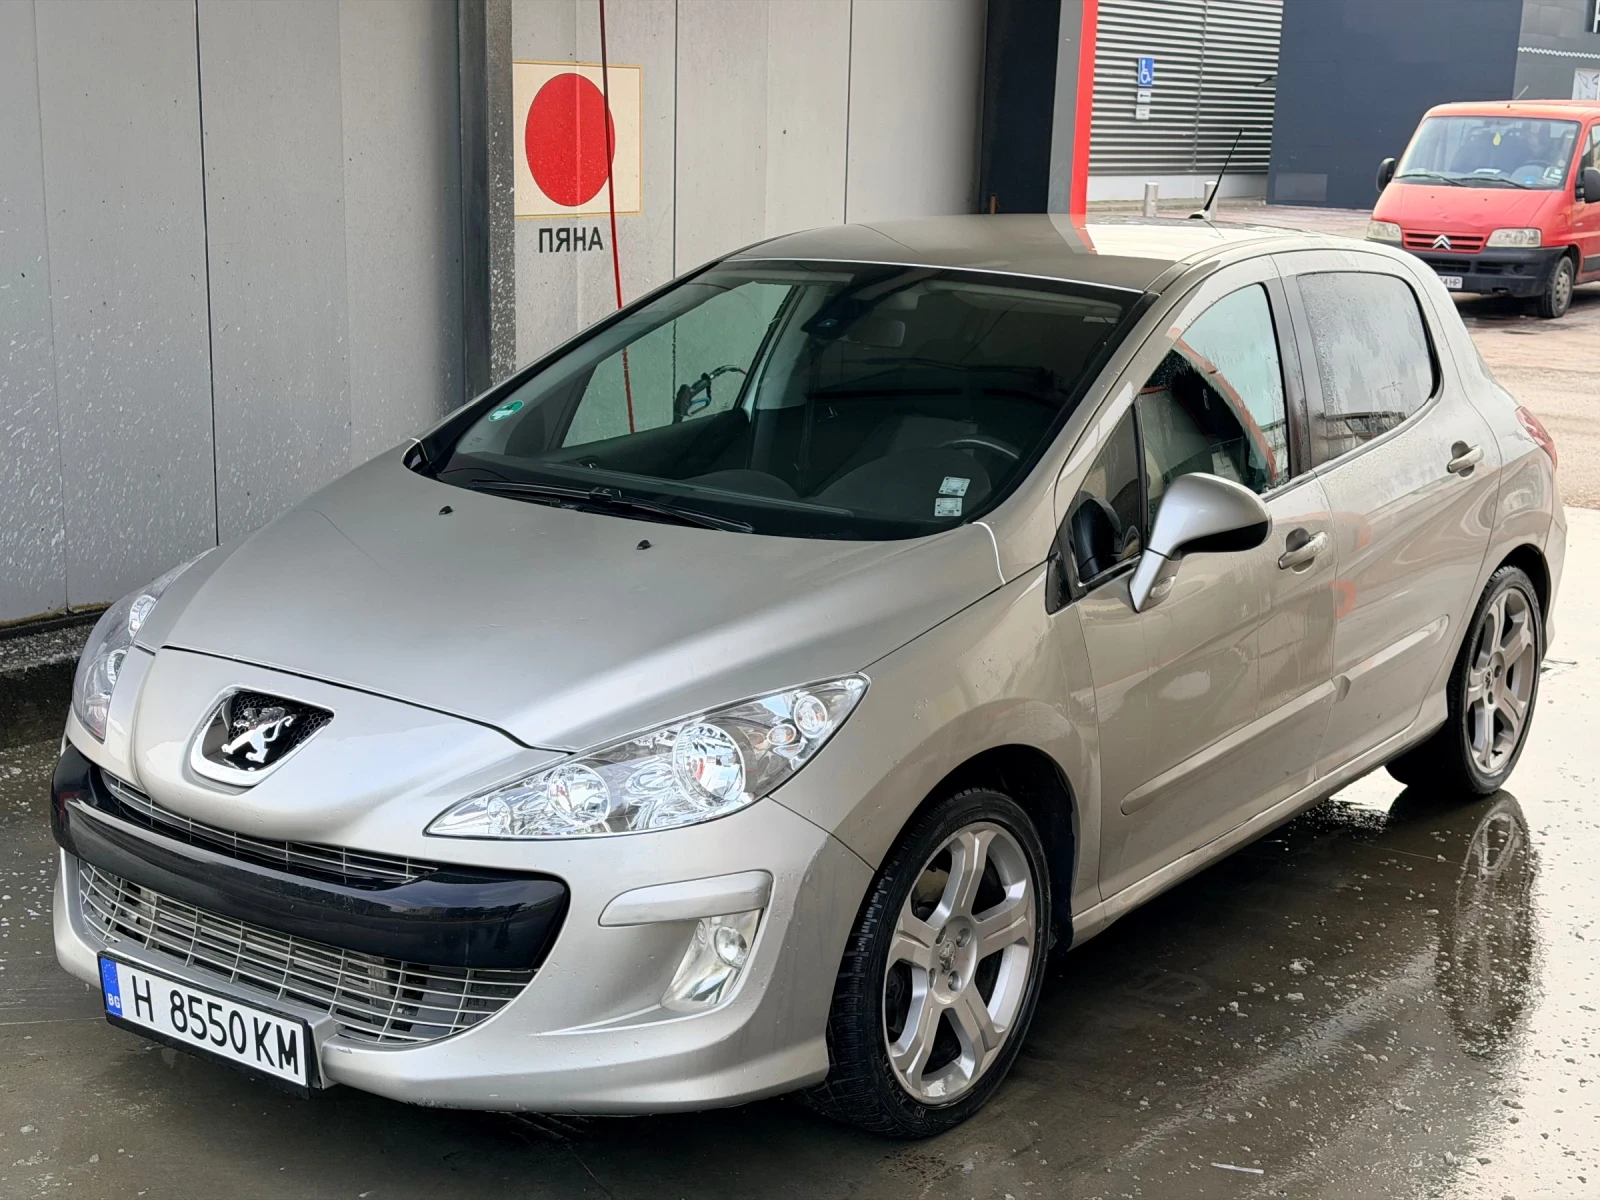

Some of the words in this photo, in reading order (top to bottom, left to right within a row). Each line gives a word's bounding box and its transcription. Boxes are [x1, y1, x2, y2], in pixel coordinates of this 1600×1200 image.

[538, 226, 604, 253] ПЯНА
[107, 993, 121, 1008] BG
[131, 975, 154, 1022] H
